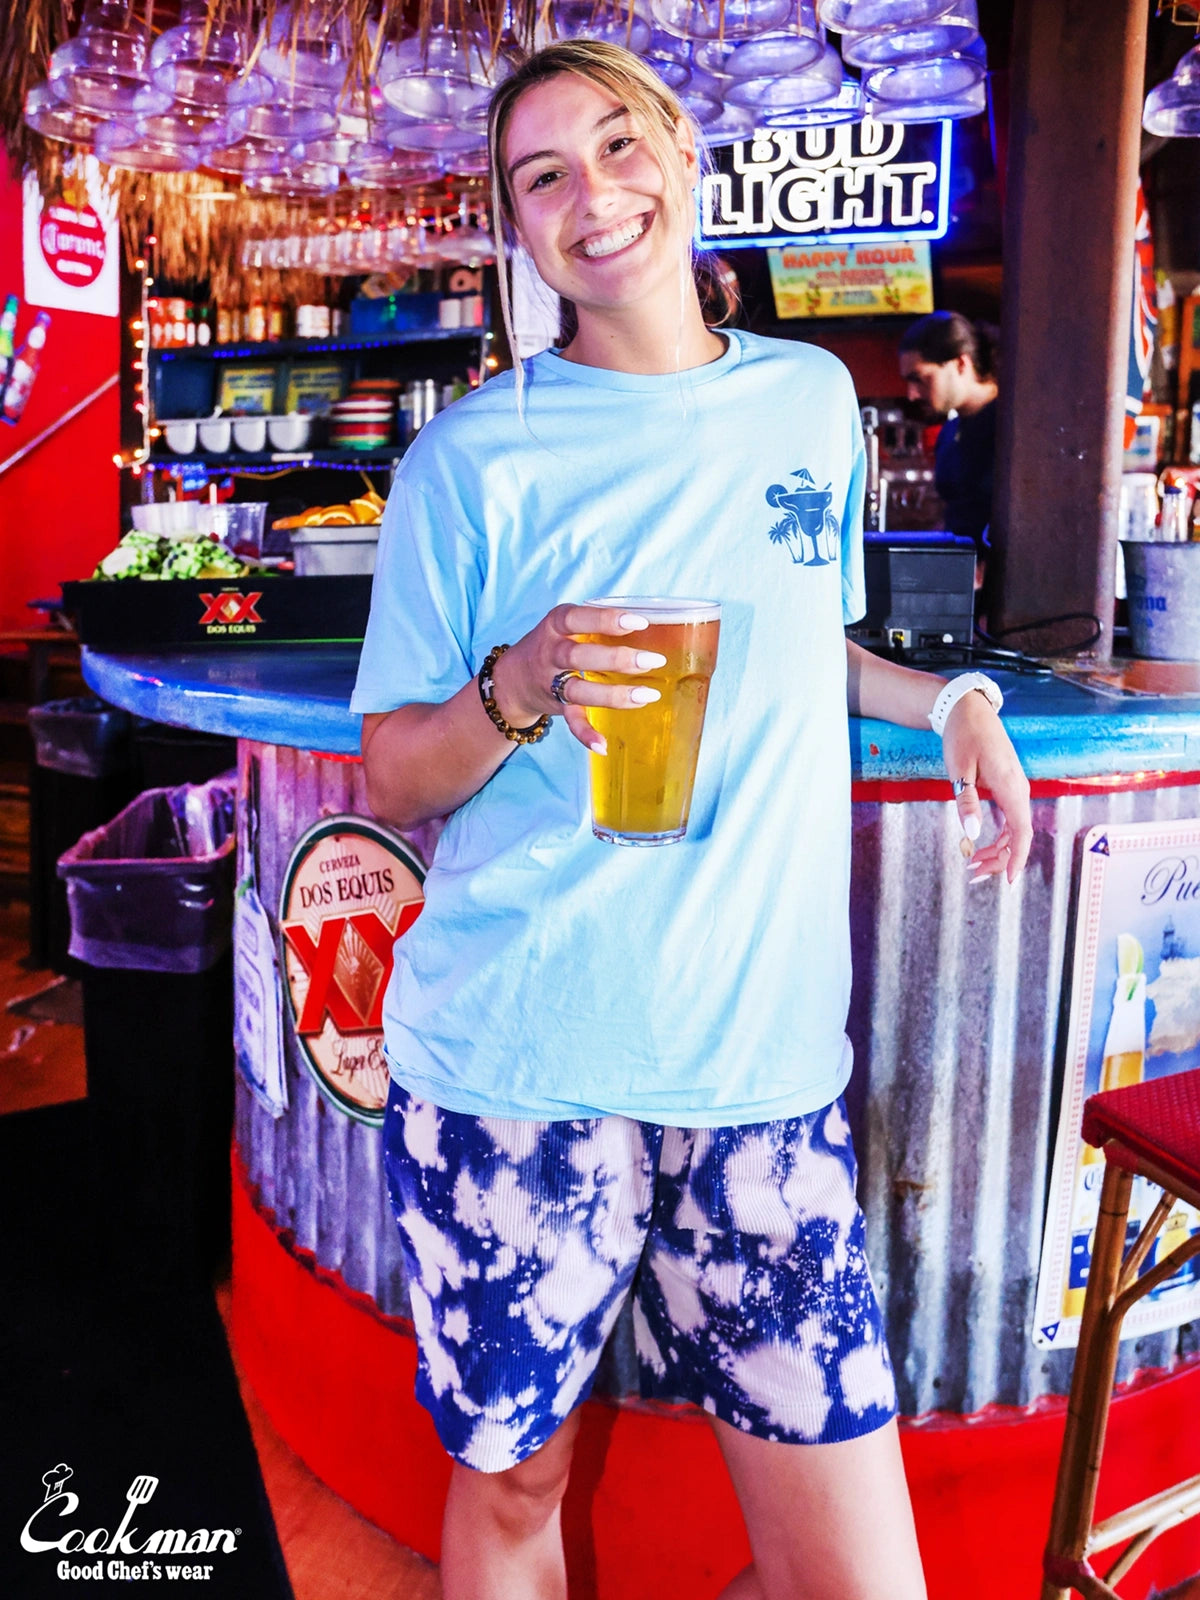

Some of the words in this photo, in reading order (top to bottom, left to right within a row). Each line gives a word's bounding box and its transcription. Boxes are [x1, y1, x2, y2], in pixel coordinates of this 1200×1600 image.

[733, 115, 905, 173] BUD
[783, 251, 848, 269] HAPPY
[856, 247, 916, 265] HOUR
[207, 625, 227, 634] DOS
[228, 625, 256, 634] EQUIS
[319, 854, 361, 874] CERVEZA
[300, 881, 333, 908] DOS
[336, 868, 395, 901] EQUIS
